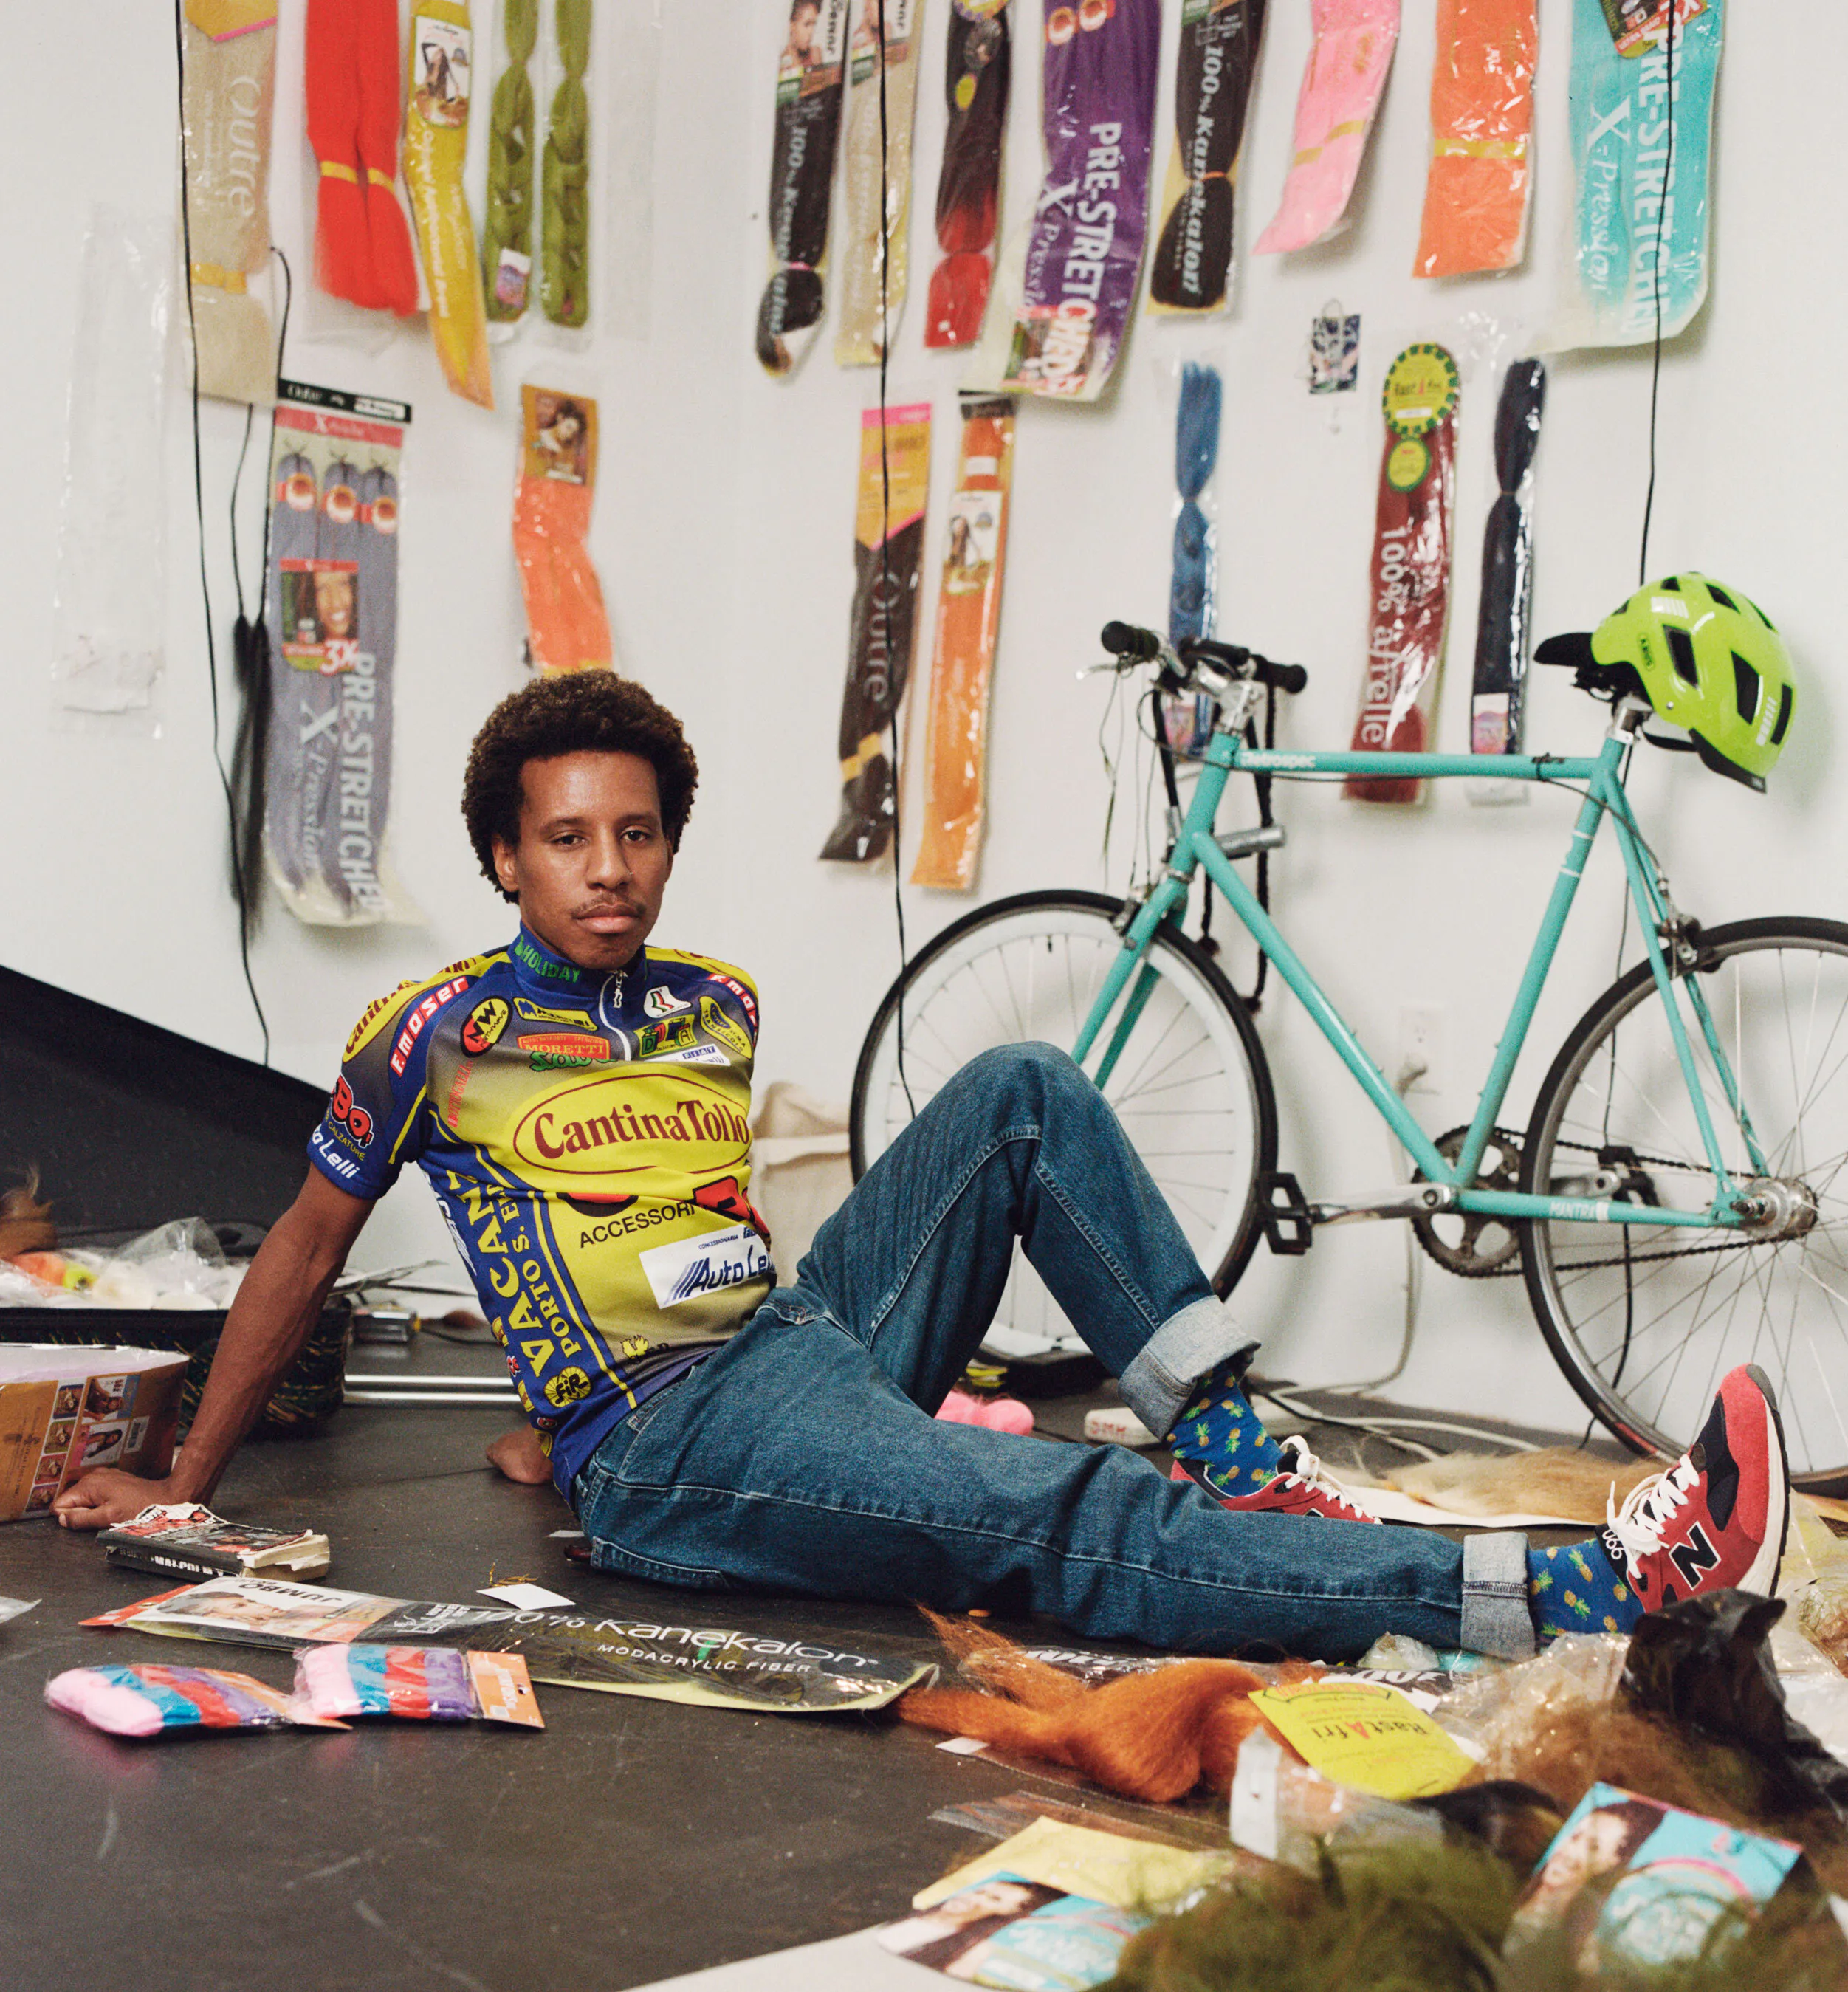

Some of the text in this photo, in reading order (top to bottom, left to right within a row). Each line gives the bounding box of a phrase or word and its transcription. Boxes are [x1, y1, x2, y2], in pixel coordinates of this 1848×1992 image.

[229, 75, 261, 217] Outre
[862, 570, 899, 702] Outre
[521, 945, 581, 983] HOLIDAY
[393, 976, 467, 1072] F.moser
[466, 1000, 498, 1043] NW
[524, 1044, 604, 1054] MORETTI
[683, 1045, 715, 1059] FIAT
[320, 1137, 361, 1179] Lelli
[328, 1122, 365, 1161] CALZATURE
[1549, 1201, 1596, 1220] MANTRA
[698, 1233, 739, 1251] CONCESSIONARIA
[522, 1258, 583, 1358] PORTO
[1669, 1520, 1722, 1590] N
[238, 1583, 343, 1603] JUMBO
[592, 1619, 871, 1669] Kanekalon
[597, 1644, 812, 1674] MODACRYLIC FIBER
[1312, 1720, 1429, 1744] RastAfri
